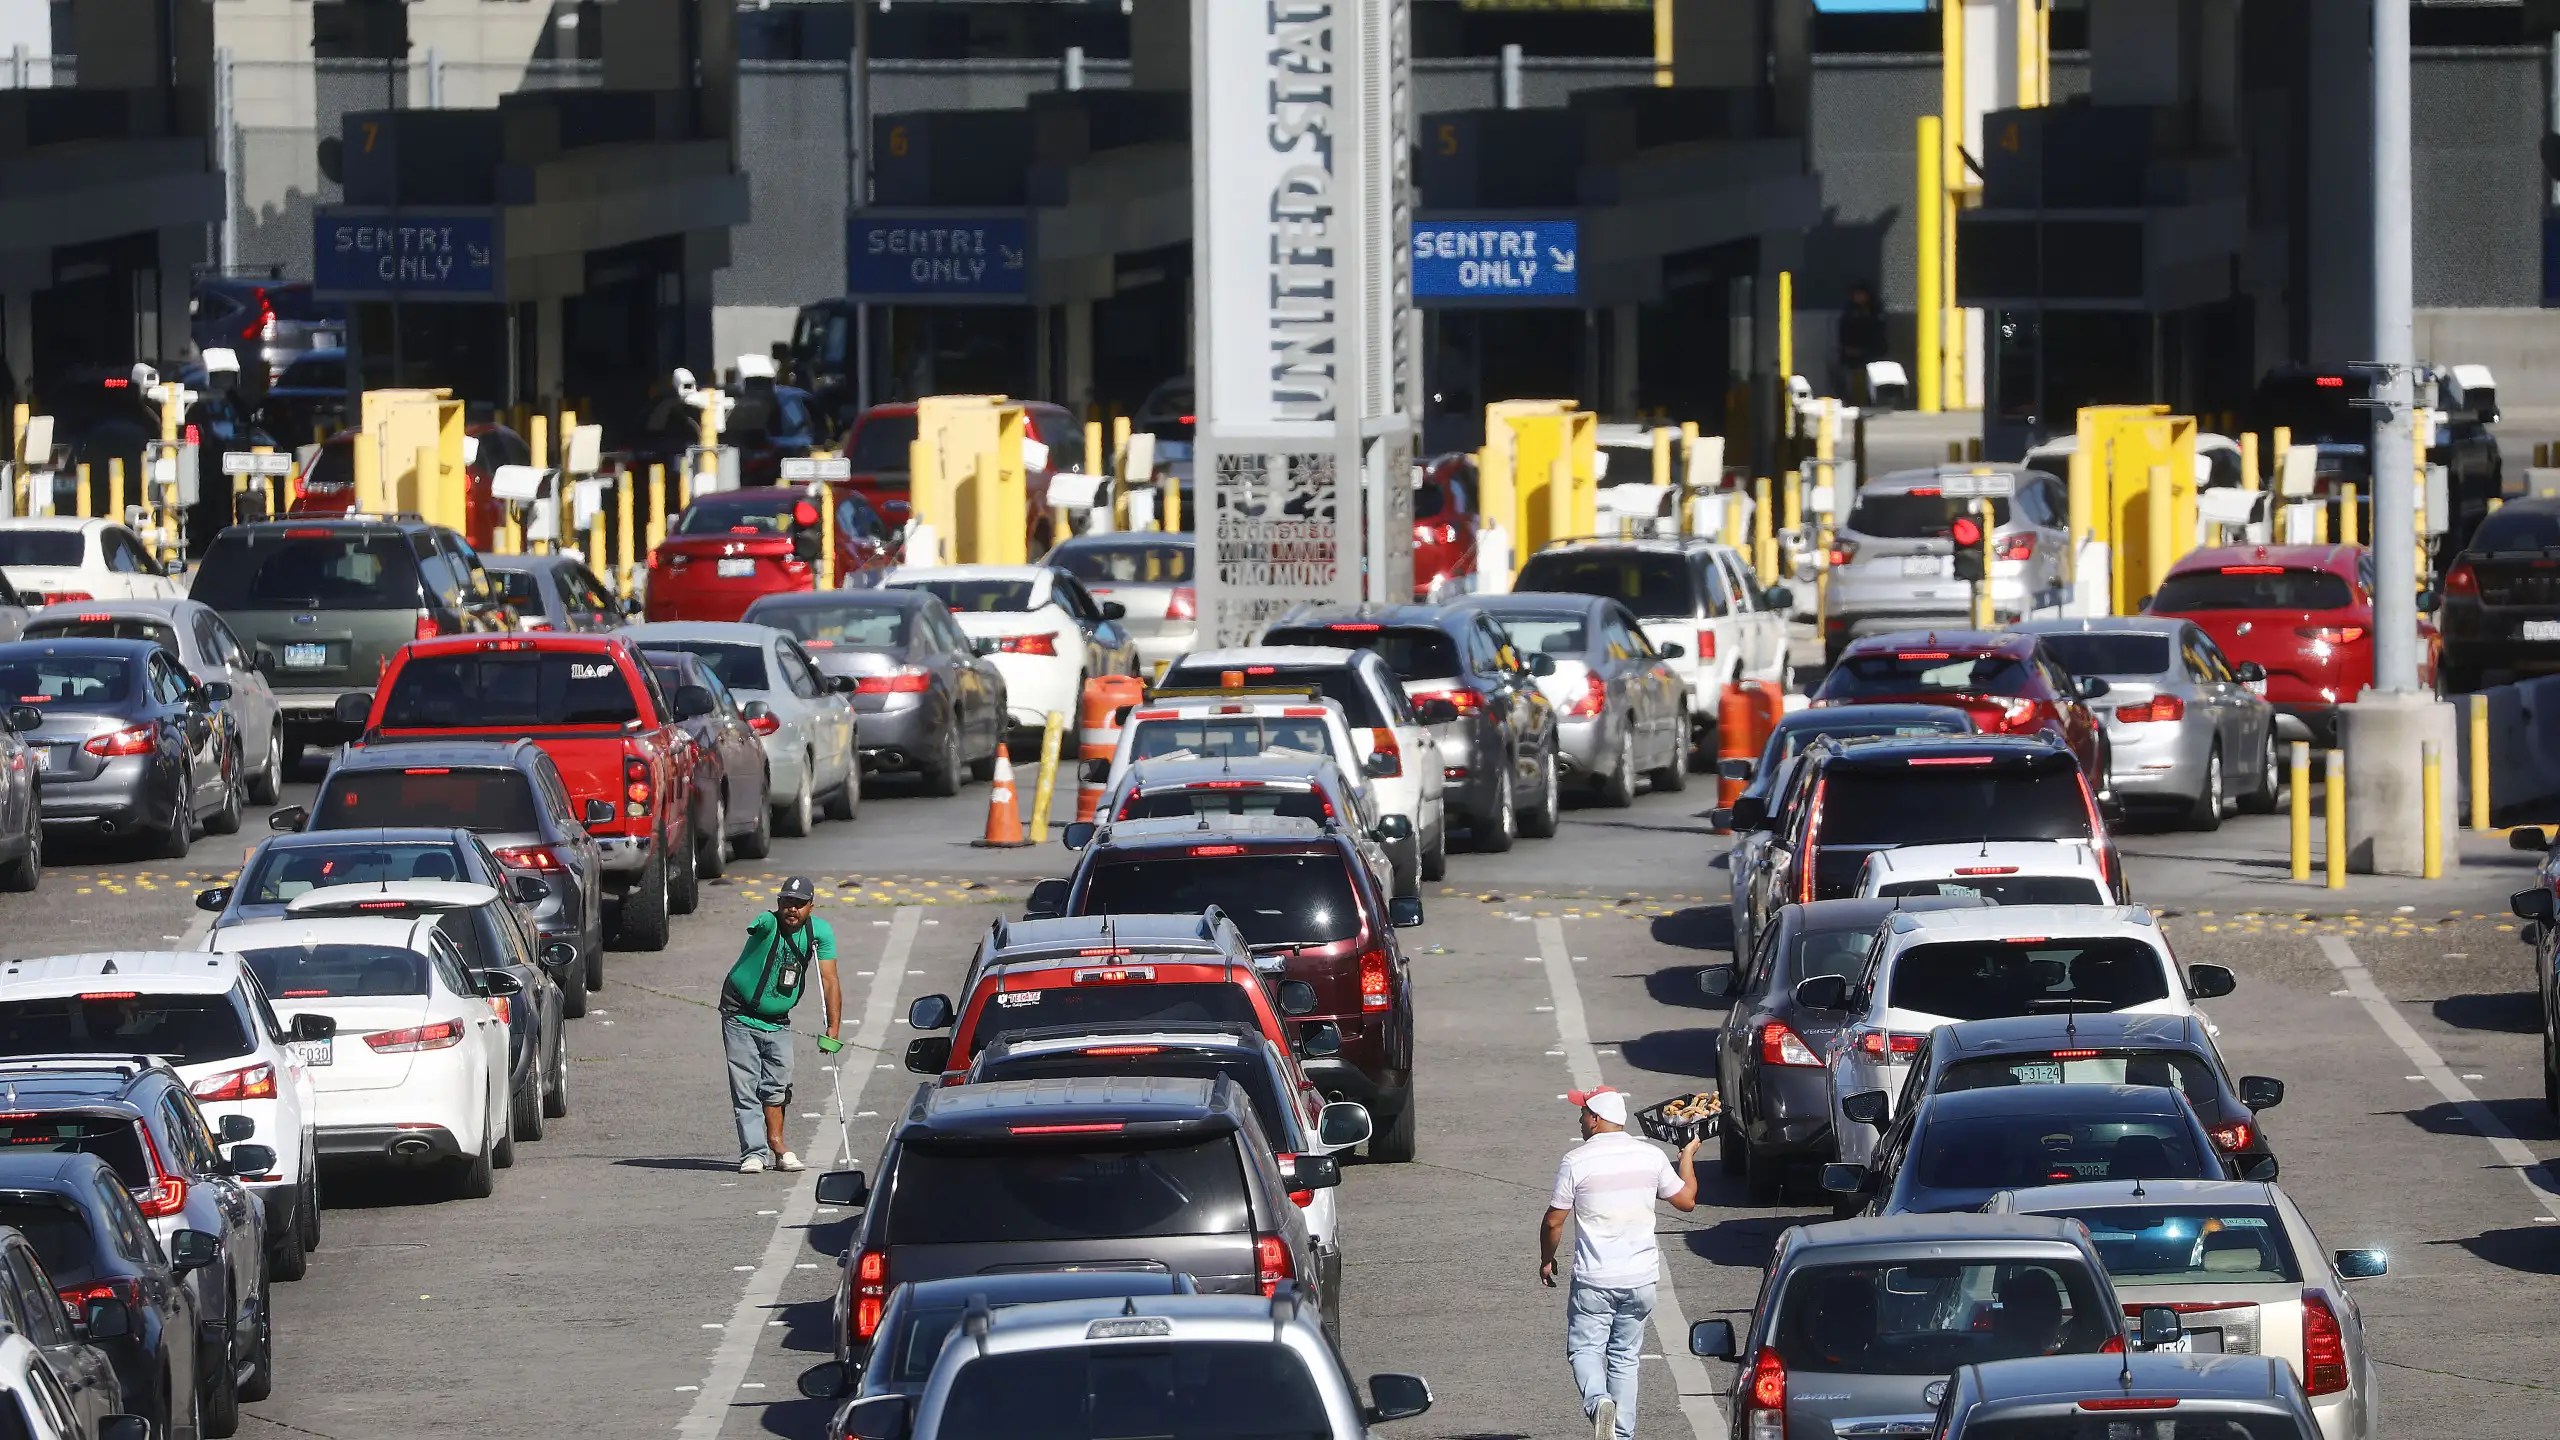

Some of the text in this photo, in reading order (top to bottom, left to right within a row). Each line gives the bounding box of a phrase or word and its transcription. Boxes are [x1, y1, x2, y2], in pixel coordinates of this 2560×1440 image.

[362, 123, 378, 152] 7
[890, 126, 908, 156] 6
[1439, 125, 1457, 154] 5
[335, 227, 452, 251] SENTRI
[868, 230, 985, 253] SENTRI
[1413, 231, 1537, 259] SENTRI
[379, 256, 452, 281] ONLY
[911, 258, 986, 283] ONLY
[1458, 260, 1537, 287] ONLY
[1269, 165, 1334, 421] UNITED
[1009, 991, 1041, 1003] TECATE
